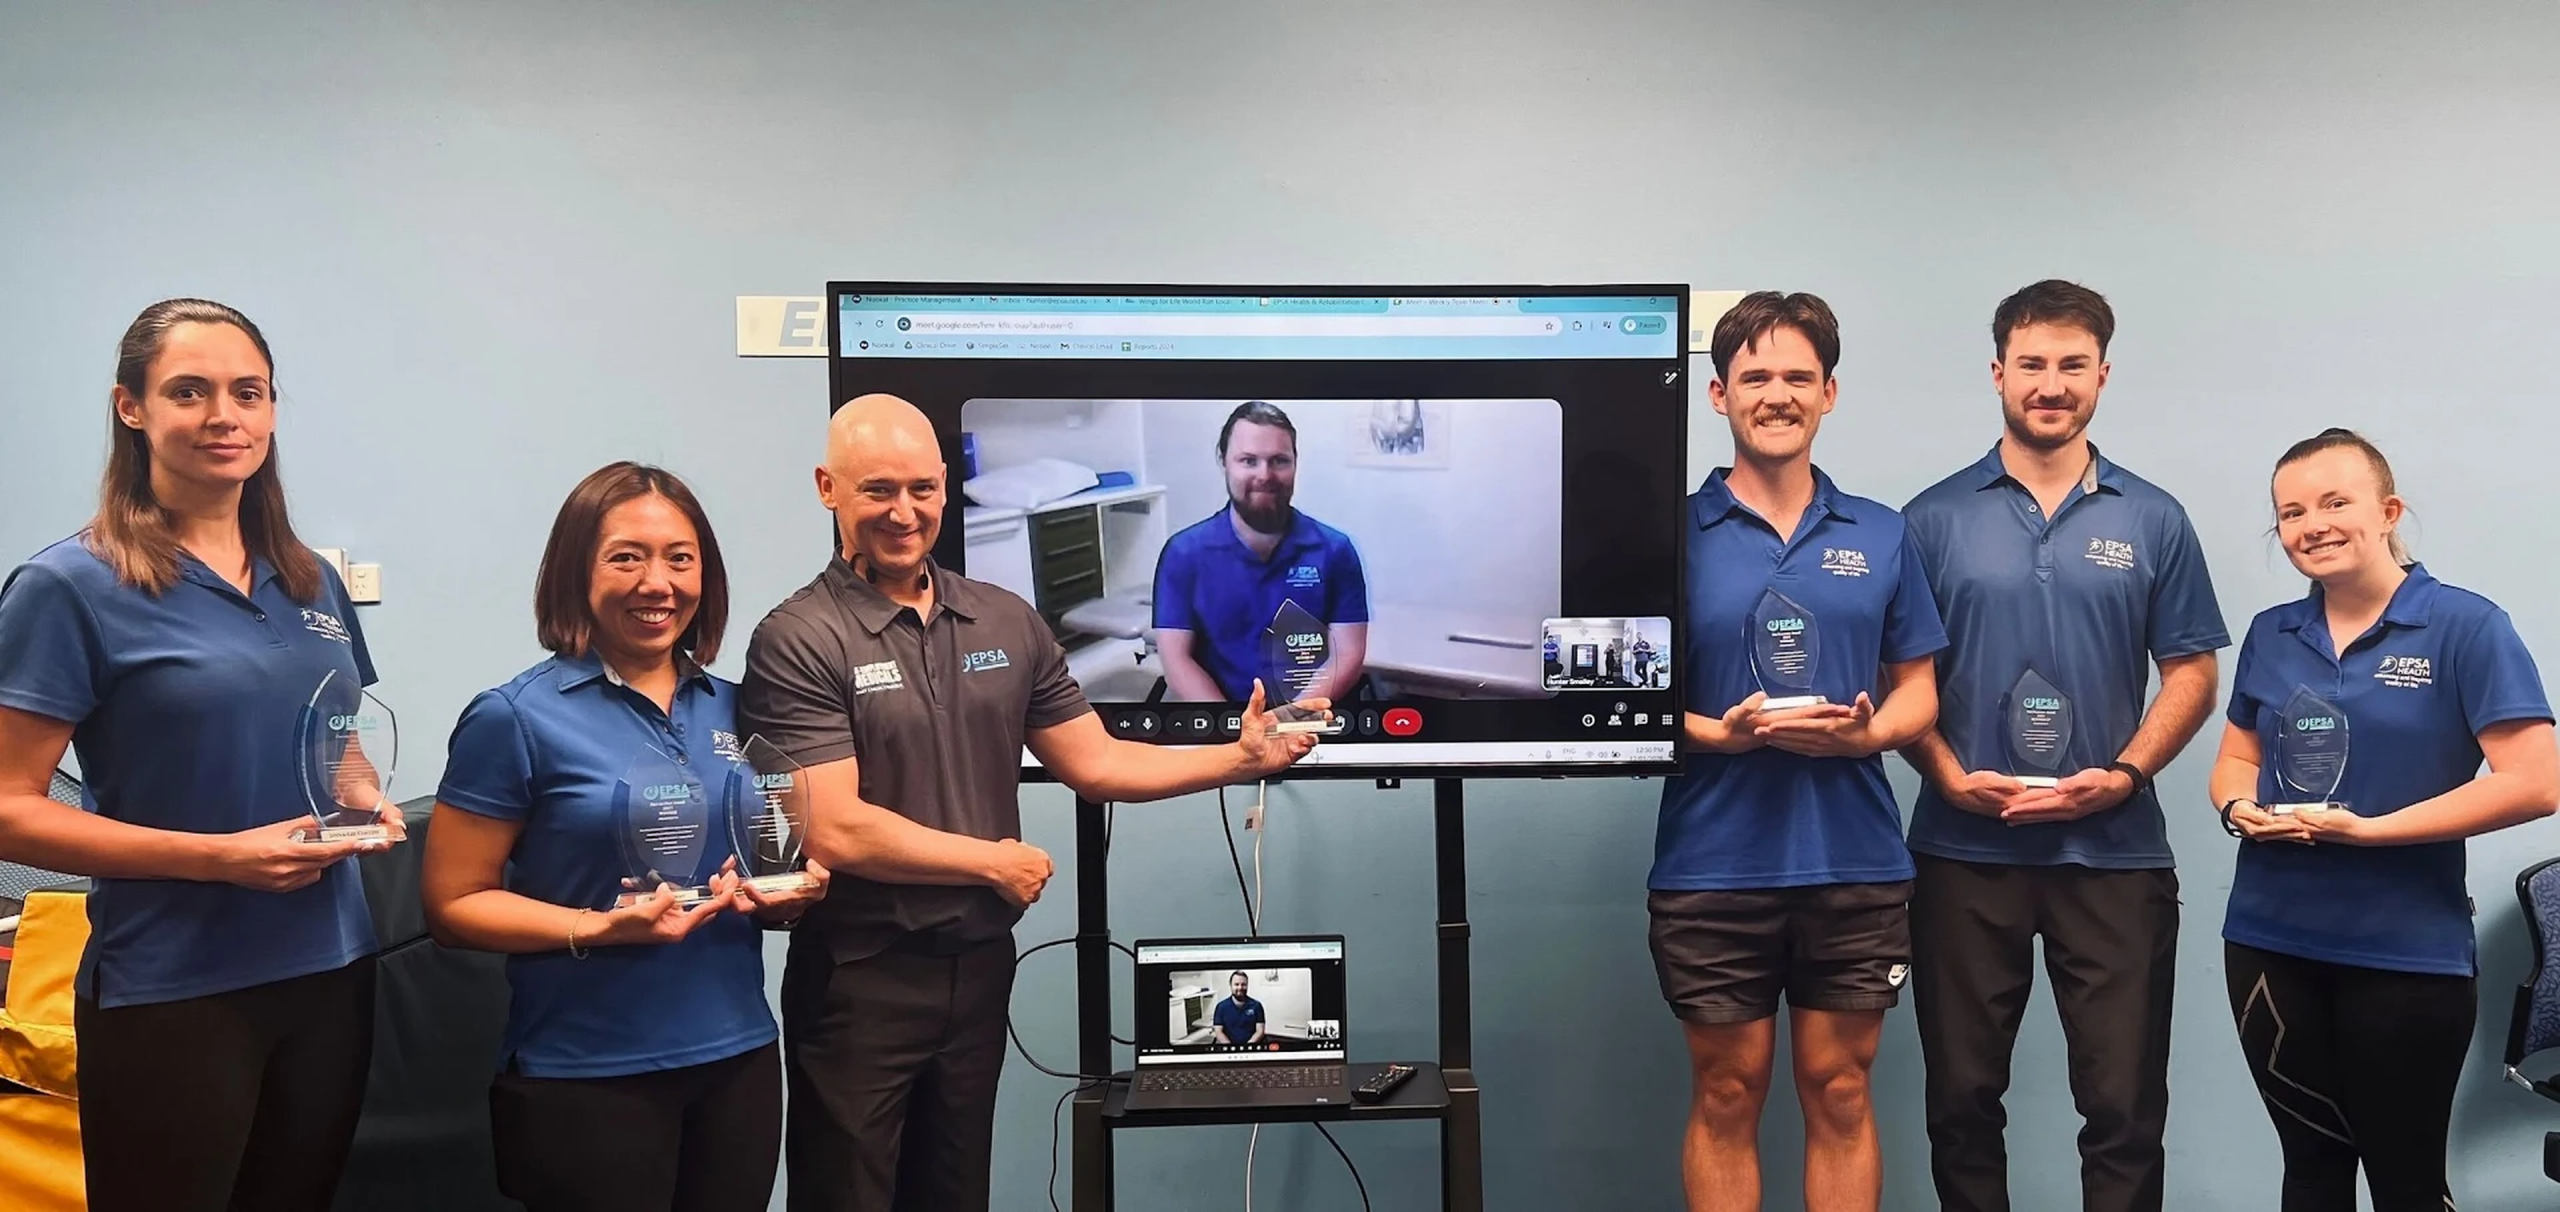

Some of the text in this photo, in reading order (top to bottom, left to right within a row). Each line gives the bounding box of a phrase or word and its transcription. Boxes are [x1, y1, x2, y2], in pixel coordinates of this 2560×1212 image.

[920, 296, 962, 304] Management
[2105, 540, 2133, 553] EPSA
[1838, 549, 1865, 560] EPSA
[1780, 617, 1805, 627] EPSA
[1298, 633, 1323, 643] EPSA
[970, 648, 1009, 665] EPSA
[2398, 657, 2430, 669] EPSA
[2397, 667, 2430, 677] HEALTH
[2035, 697, 2060, 707] EPSA
[2309, 717, 2335, 727] EPSA
[766, 773, 794, 784] EPSA
[659, 784, 690, 794] EPSA
